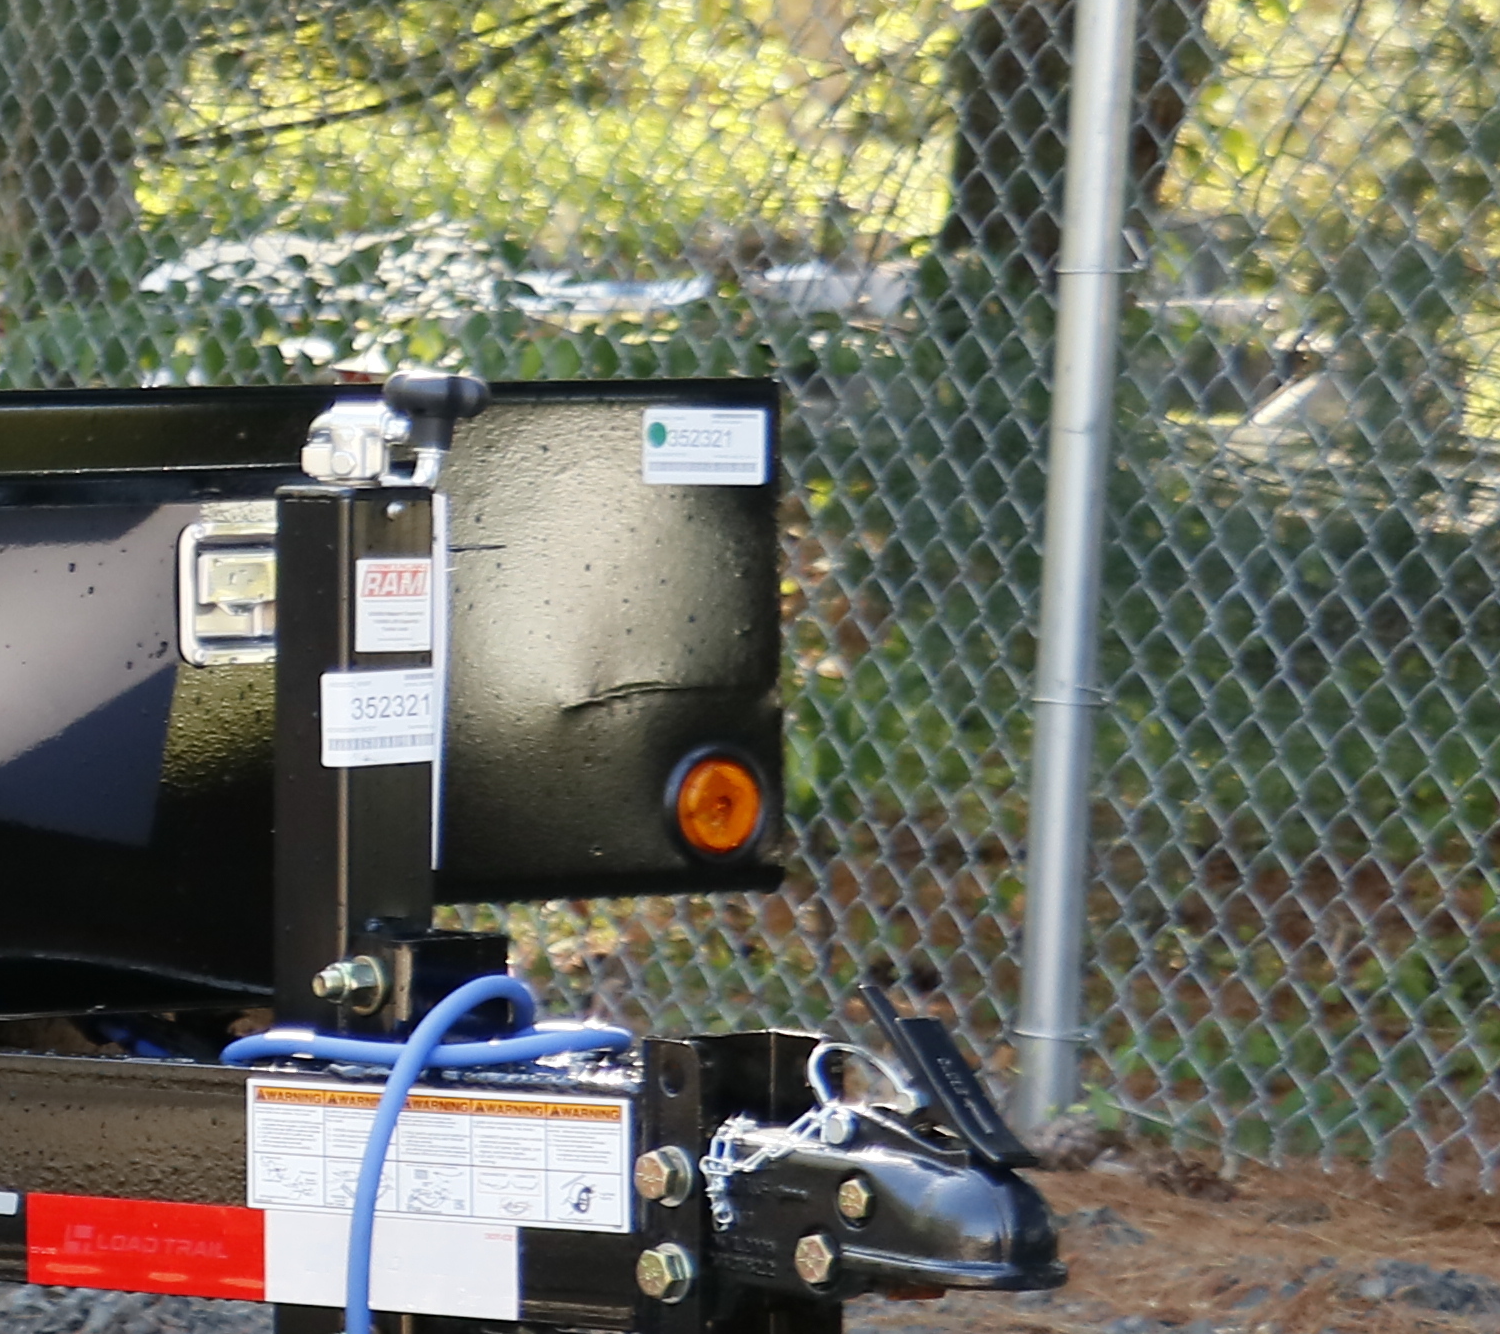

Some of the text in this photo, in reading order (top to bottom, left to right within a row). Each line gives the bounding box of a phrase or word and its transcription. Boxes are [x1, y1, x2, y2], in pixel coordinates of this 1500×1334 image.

[668, 428, 732, 448] 352321
[363, 571, 425, 596] RAM
[350, 693, 431, 720] 352321
[267, 1089, 322, 1104] WARNING
[409, 1098, 469, 1112] WARNING
[485, 1103, 543, 1117] WARNING
[560, 1108, 620, 1121] WARNING
[96, 1234, 229, 1259] LOAD TRAIL
